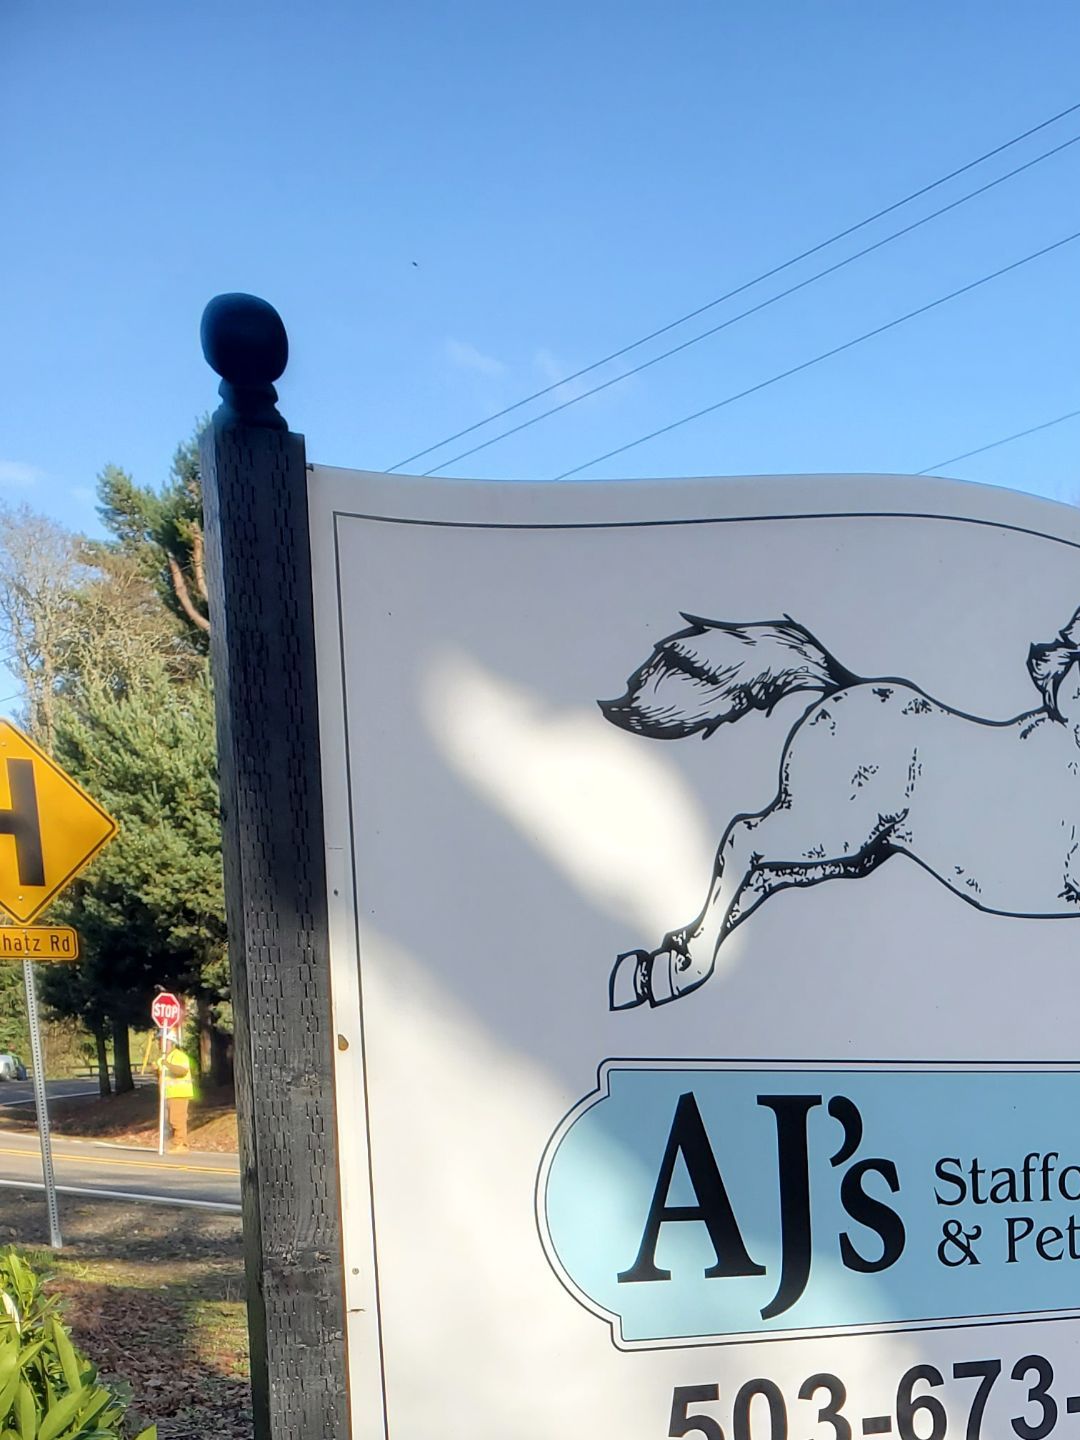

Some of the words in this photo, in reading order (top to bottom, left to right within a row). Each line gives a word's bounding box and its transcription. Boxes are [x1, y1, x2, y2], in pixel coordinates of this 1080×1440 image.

[50, 935, 70, 952] Rd
[154, 1003, 178, 1018] STOP
[617, 1091, 906, 1321] AJ's
[937, 1223, 983, 1267] &
